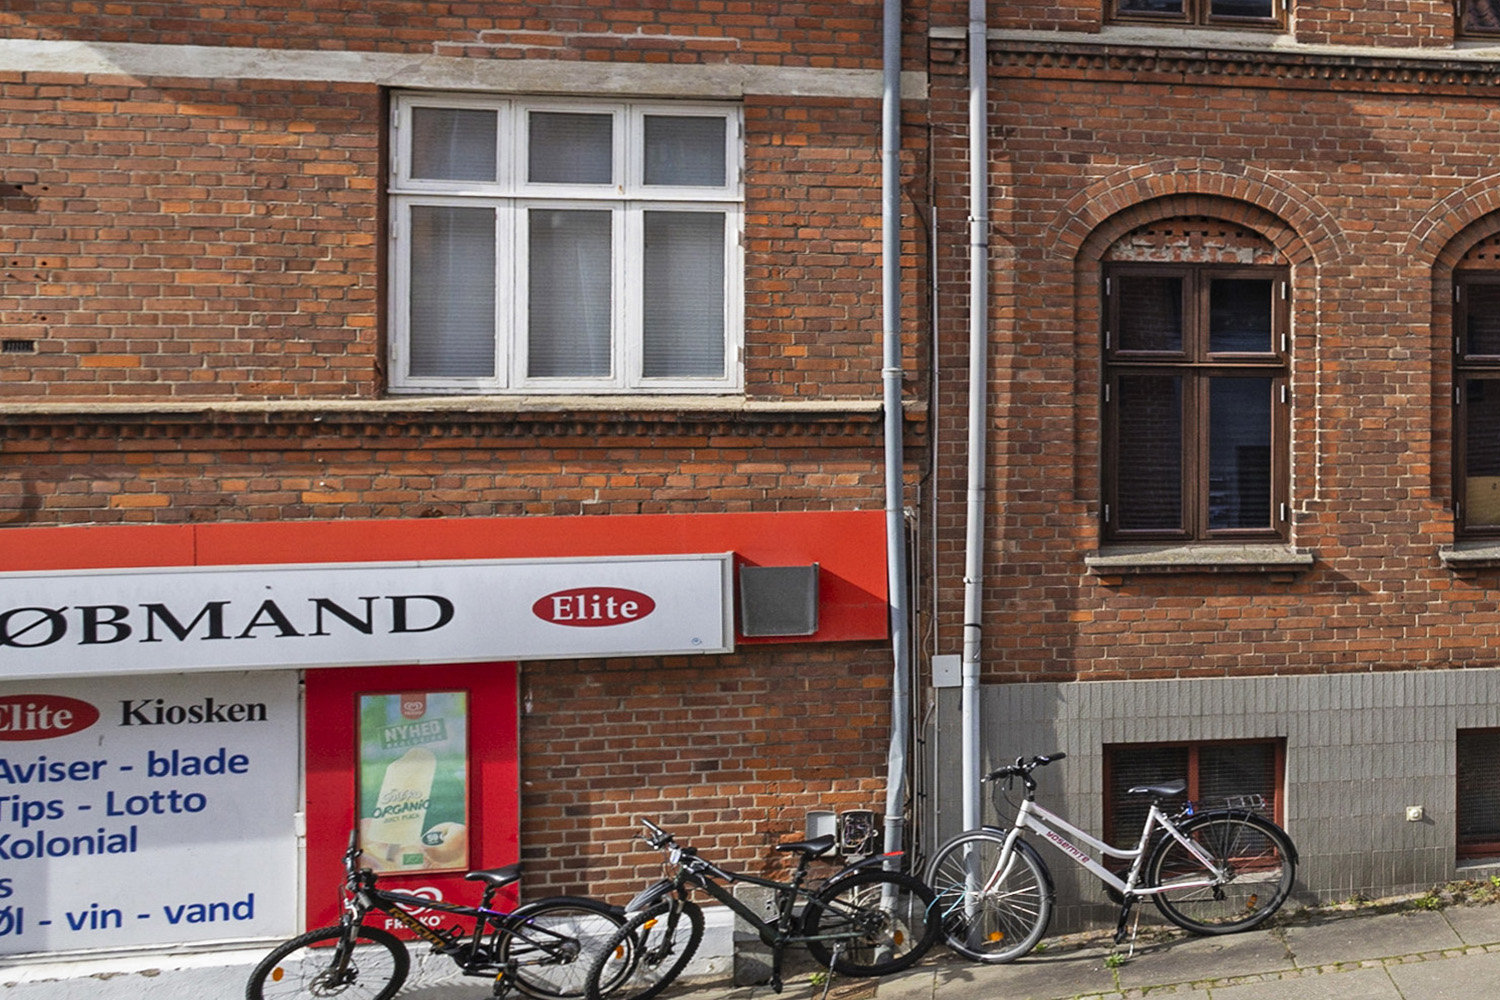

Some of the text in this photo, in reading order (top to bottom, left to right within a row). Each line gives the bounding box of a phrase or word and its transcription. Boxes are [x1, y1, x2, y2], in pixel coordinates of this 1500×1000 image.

[551, 595, 639, 621] Elite
[118, 698, 268, 727] Kiosken
[384, 720, 441, 743] NYHED
[0, 755, 107, 784] Aviser
[147, 747, 249, 778] blade
[106, 790, 207, 817] Lotto
[65, 903, 122, 931] vin
[163, 893, 255, 925] vand
[385, 916, 440, 929] FRKO
